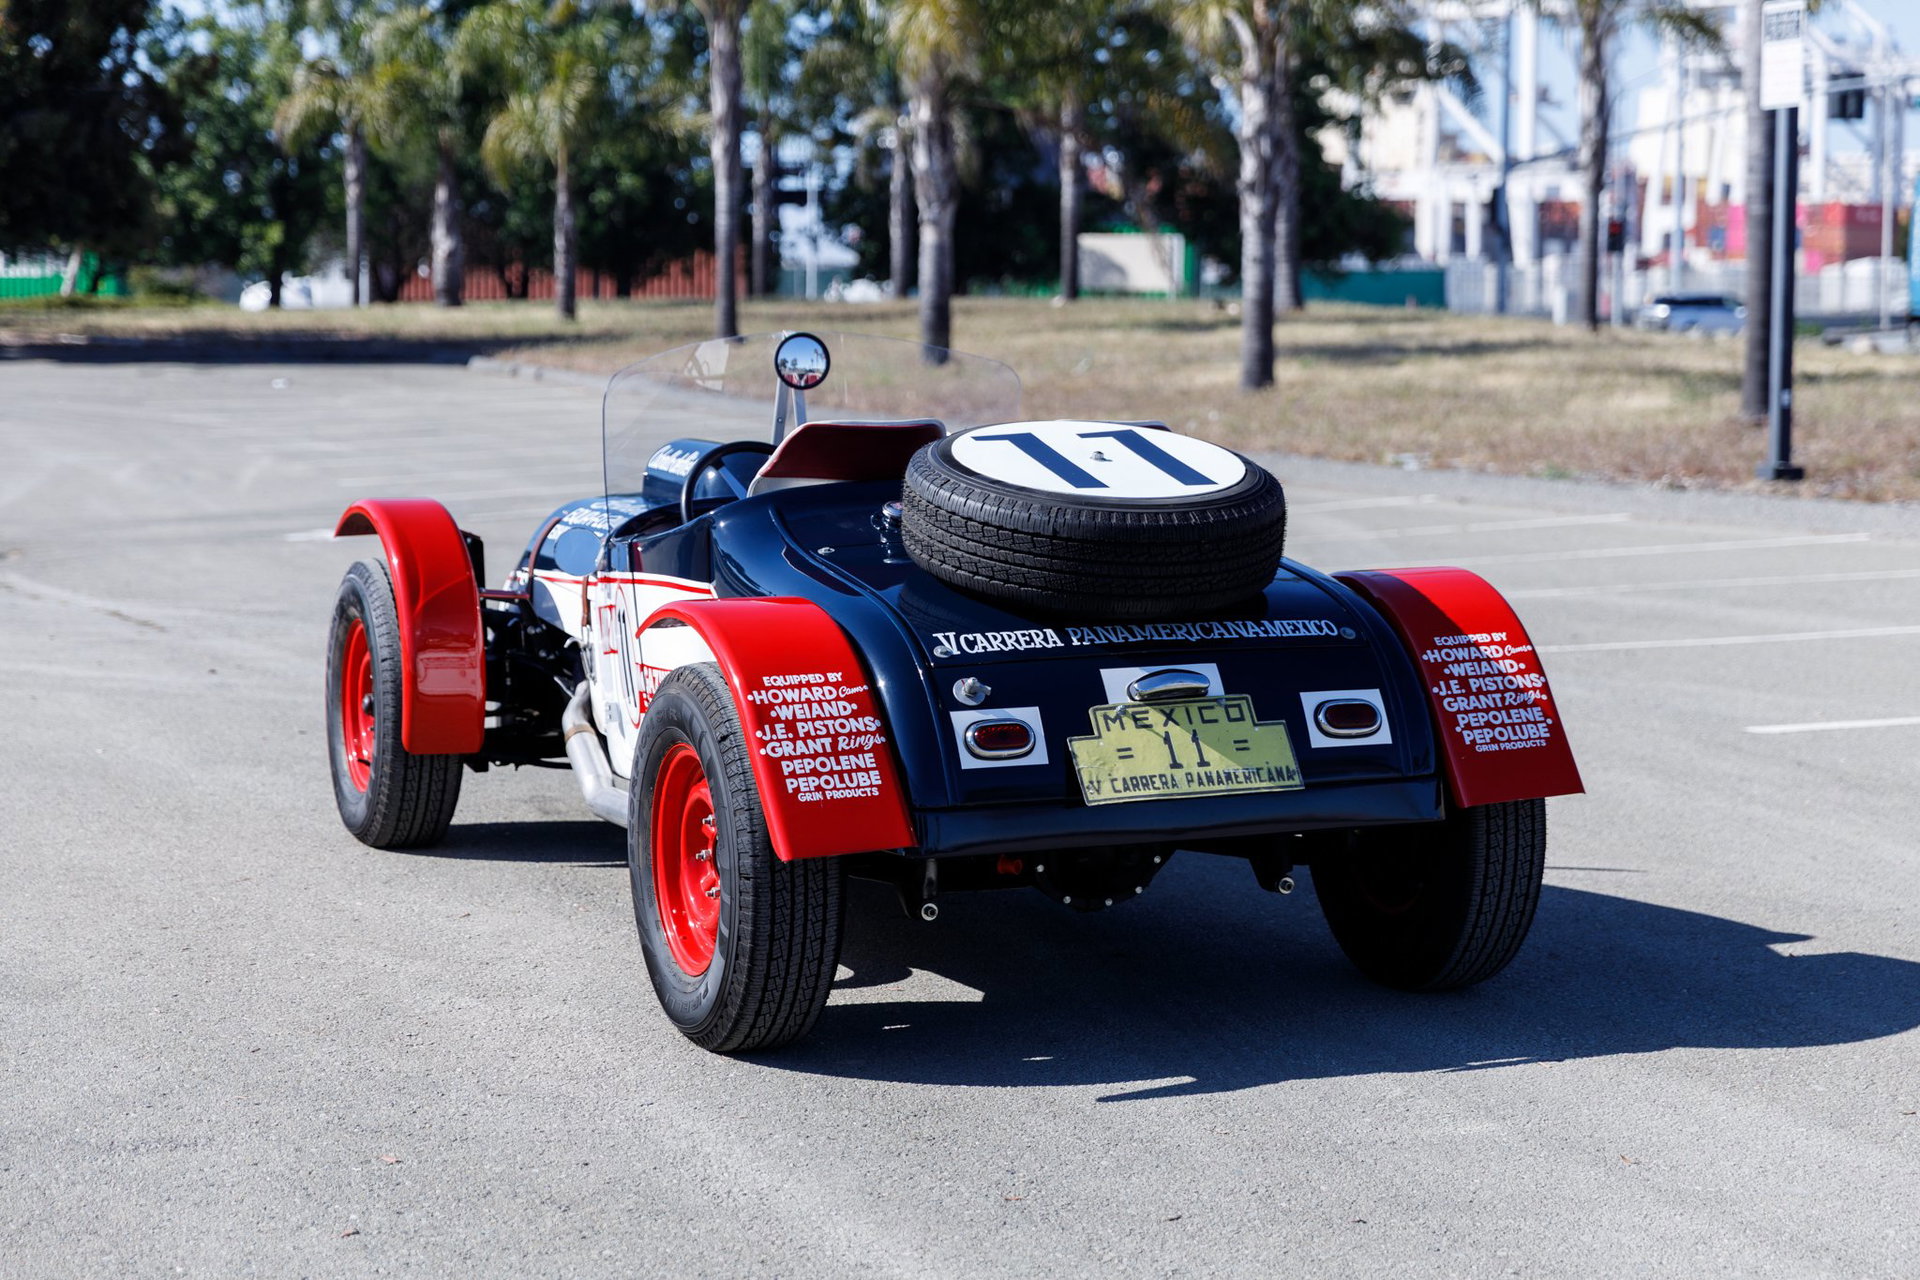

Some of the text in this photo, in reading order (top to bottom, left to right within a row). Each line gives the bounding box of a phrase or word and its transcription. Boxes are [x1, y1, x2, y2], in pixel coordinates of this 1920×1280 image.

[971, 429, 1217, 489] 11
[933, 632, 960, 655] V
[960, 628, 1064, 654] CARRERA
[1434, 632, 1507, 646] EQUIPPED BY
[1425, 645, 1503, 663] HOWARD
[1449, 660, 1518, 677] WEIAND
[762, 672, 842, 687] EQUIPPED BY
[1468, 673, 1542, 693] PISTONS
[753, 685, 864, 705] HOWARD Cams
[1443, 693, 1503, 712] GRANT
[775, 702, 852, 721] WEIAND
[1103, 703, 1246, 731] MEXICO
[1457, 707, 1544, 728] PEPOLENE
[762, 717, 877, 741] J.E. PISTONS
[1462, 723, 1550, 745] PEPOLUBE
[766, 732, 881, 758] GRANT Rings
[1163, 729, 1211, 770] 11
[1475, 739, 1546, 752] GRIN PRODUCTS
[781, 752, 877, 776] PEPOLENE
[785, 770, 882, 793] PEPOLUBE
[1110, 772, 1178, 794] CARRERA
[1185, 765, 1295, 788] PANAMERICANA
[797, 787, 879, 802] GRIN PRODUCTS
